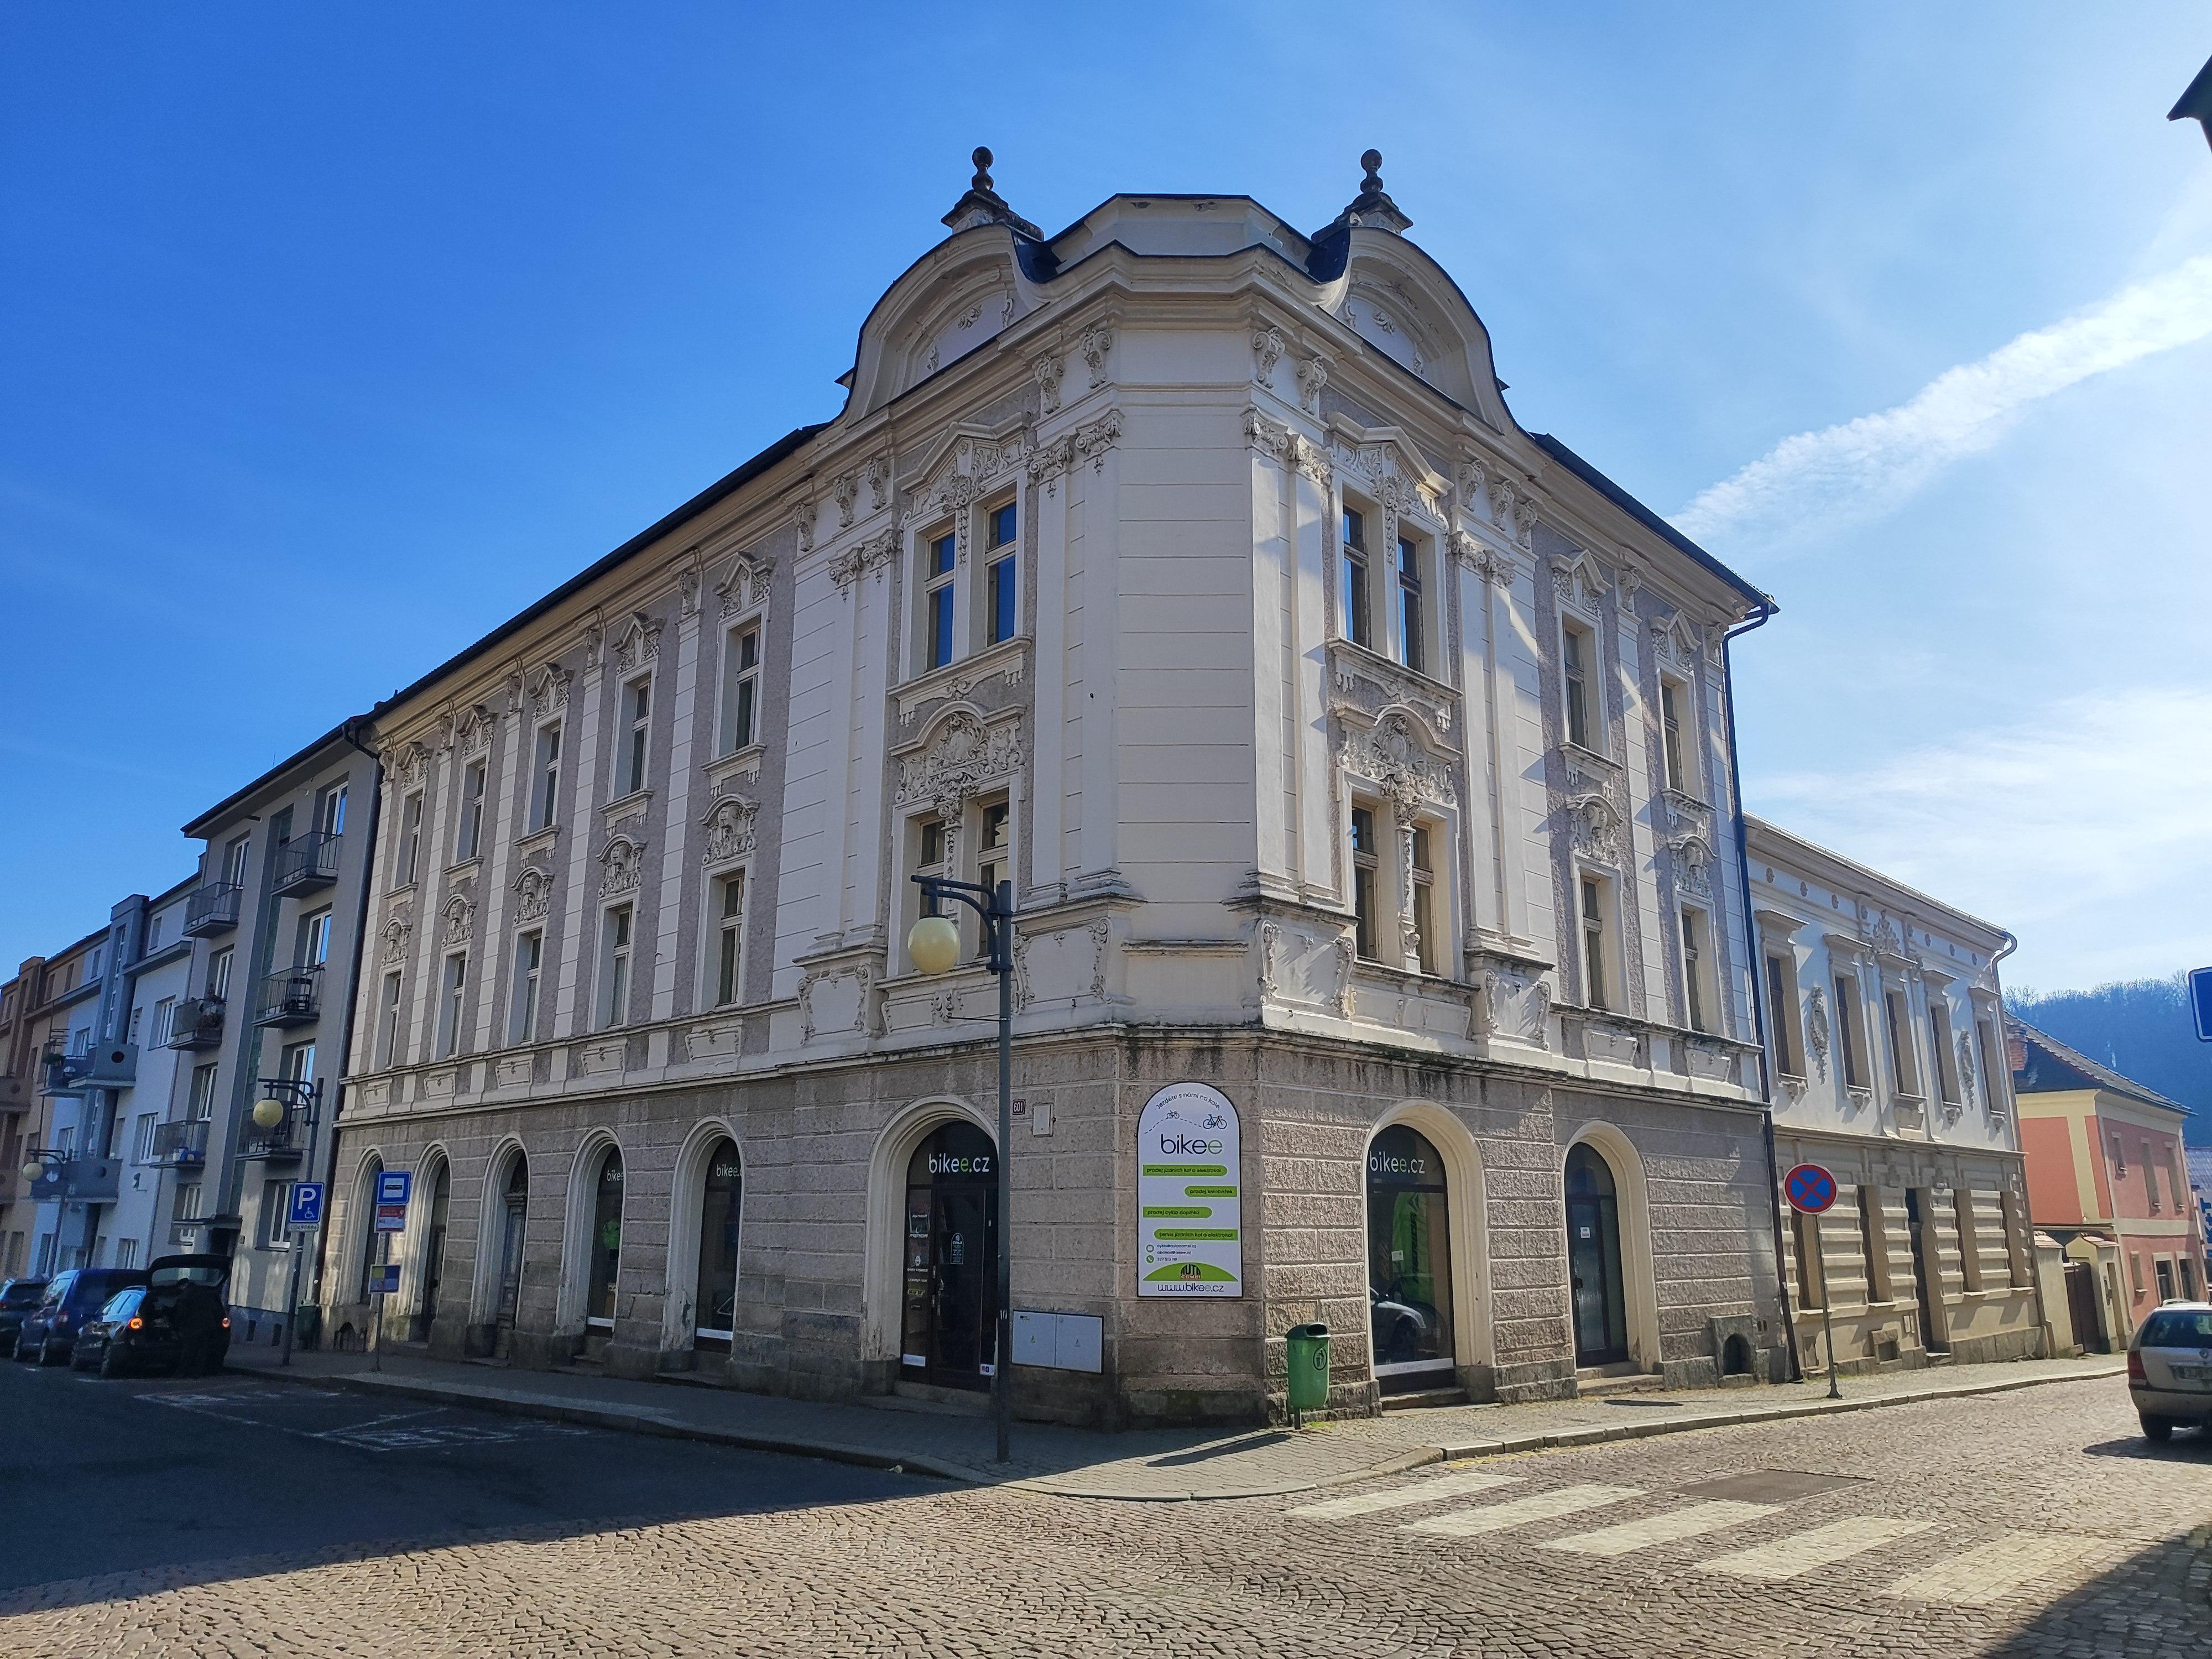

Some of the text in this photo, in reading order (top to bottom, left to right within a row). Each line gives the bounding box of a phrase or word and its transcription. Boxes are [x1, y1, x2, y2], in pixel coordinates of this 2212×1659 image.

[1014, 1101, 1023, 1113] 601
[1161, 1133, 1223, 1155] bikee
[928, 1152, 990, 1173] bikee.cz
[1369, 1150, 1425, 1174] bikee.cz
[298, 1187, 316, 1210] P
[1180, 1264, 1201, 1275] AUTO
[1157, 1282, 1224, 1292] www.bikee.cz
